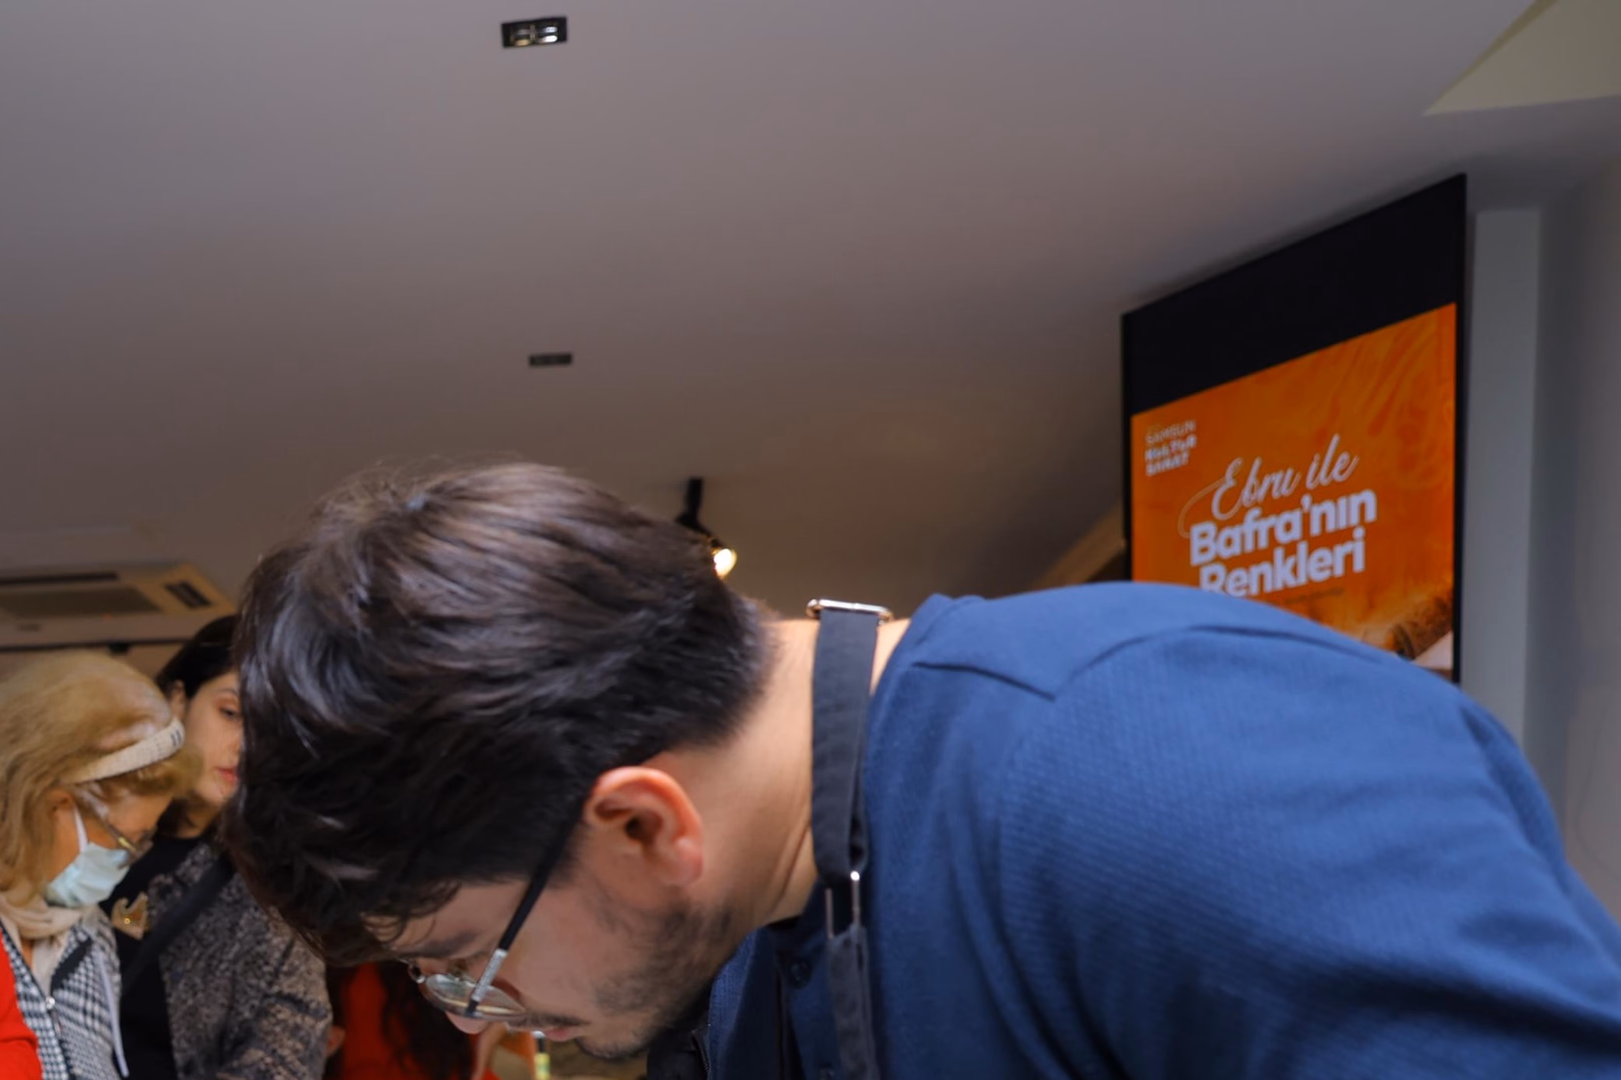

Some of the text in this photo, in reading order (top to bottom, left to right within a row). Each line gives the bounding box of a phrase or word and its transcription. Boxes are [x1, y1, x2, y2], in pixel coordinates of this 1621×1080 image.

[1193, 433, 1359, 527] Ebru ile
[1199, 526, 1366, 599] Renkleri
